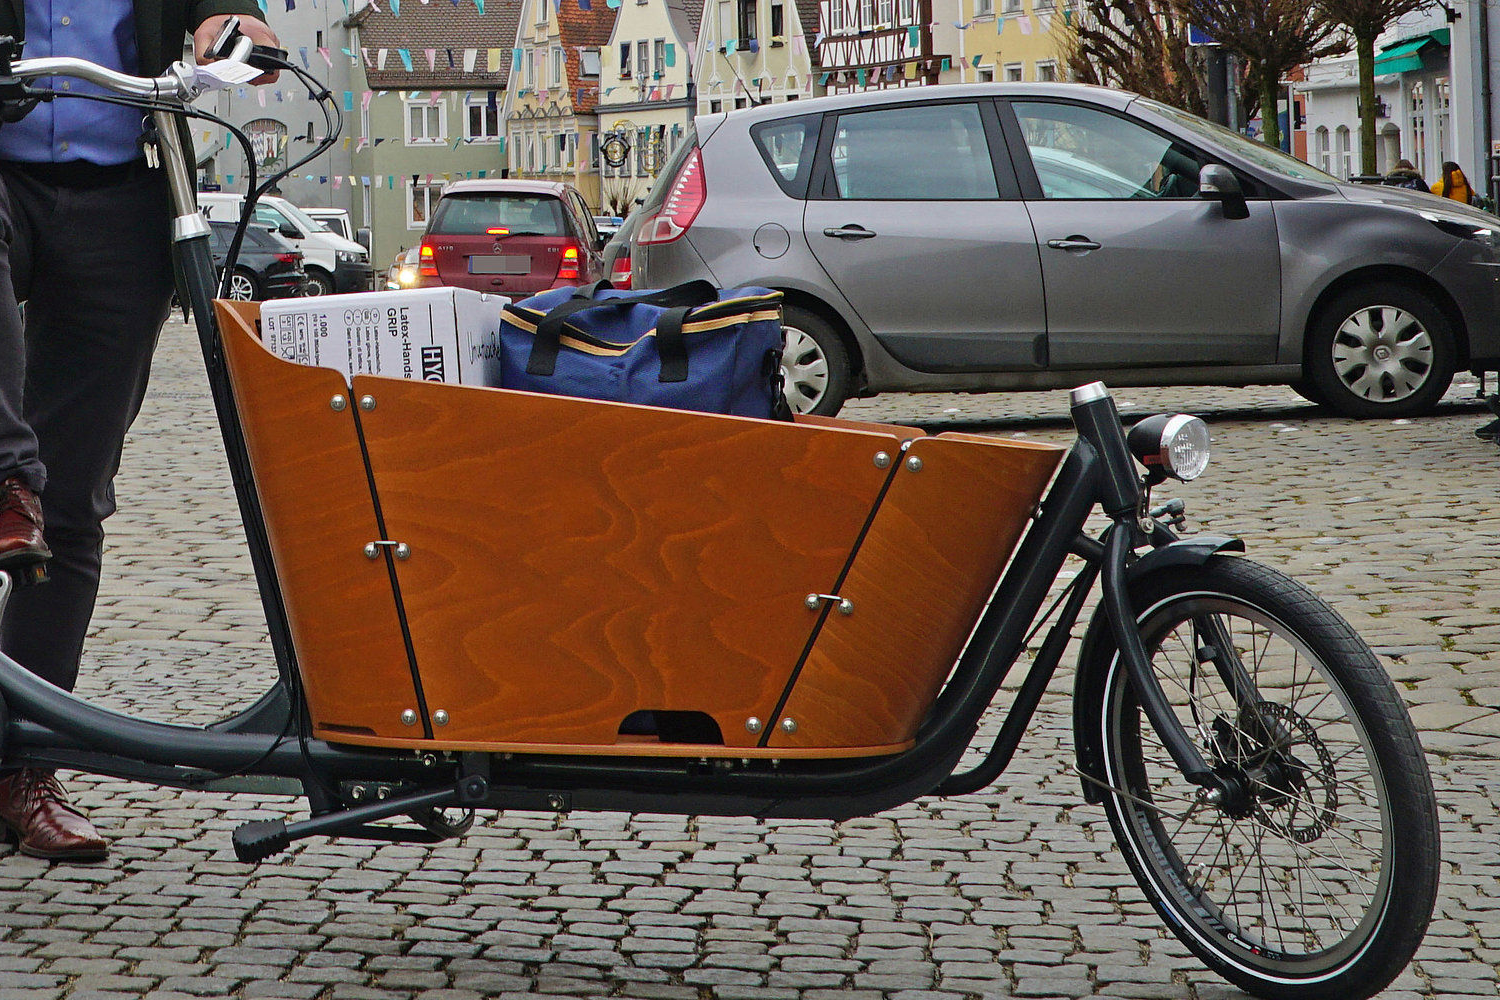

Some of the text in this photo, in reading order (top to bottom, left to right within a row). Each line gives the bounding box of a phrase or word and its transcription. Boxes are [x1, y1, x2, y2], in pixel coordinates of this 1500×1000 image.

[320, 314, 328, 337] 1.000
[387, 308, 398, 337] GRIP
[400, 307, 413, 379] Latex-Hands
